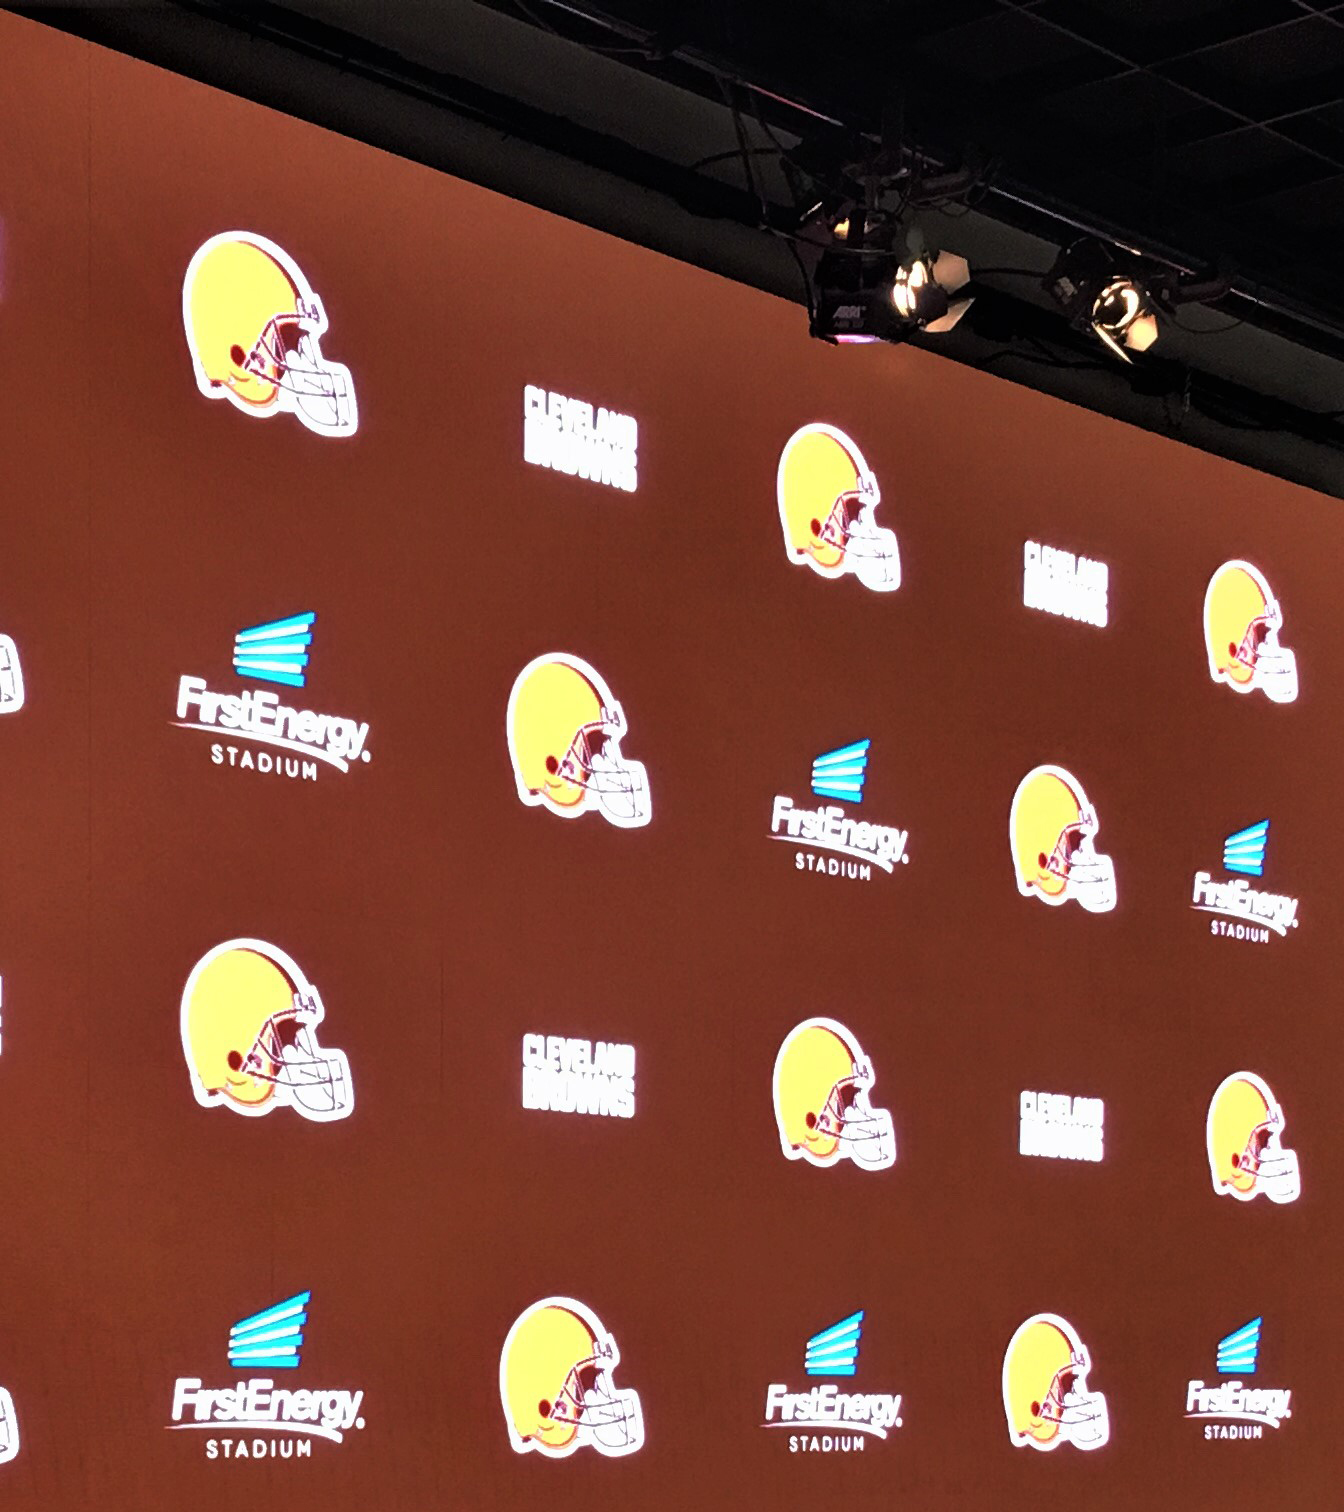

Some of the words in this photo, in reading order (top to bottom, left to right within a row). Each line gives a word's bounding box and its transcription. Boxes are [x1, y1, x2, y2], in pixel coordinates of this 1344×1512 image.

[211, 744, 317, 781] STADIUM
[795, 852, 871, 881] STADIUM
[1211, 920, 1269, 943] STADIUM
[1204, 1425, 1262, 1440] STADIUM
[206, 1439, 311, 1458] STADIUM
[789, 1435, 864, 1452] STADIUM
